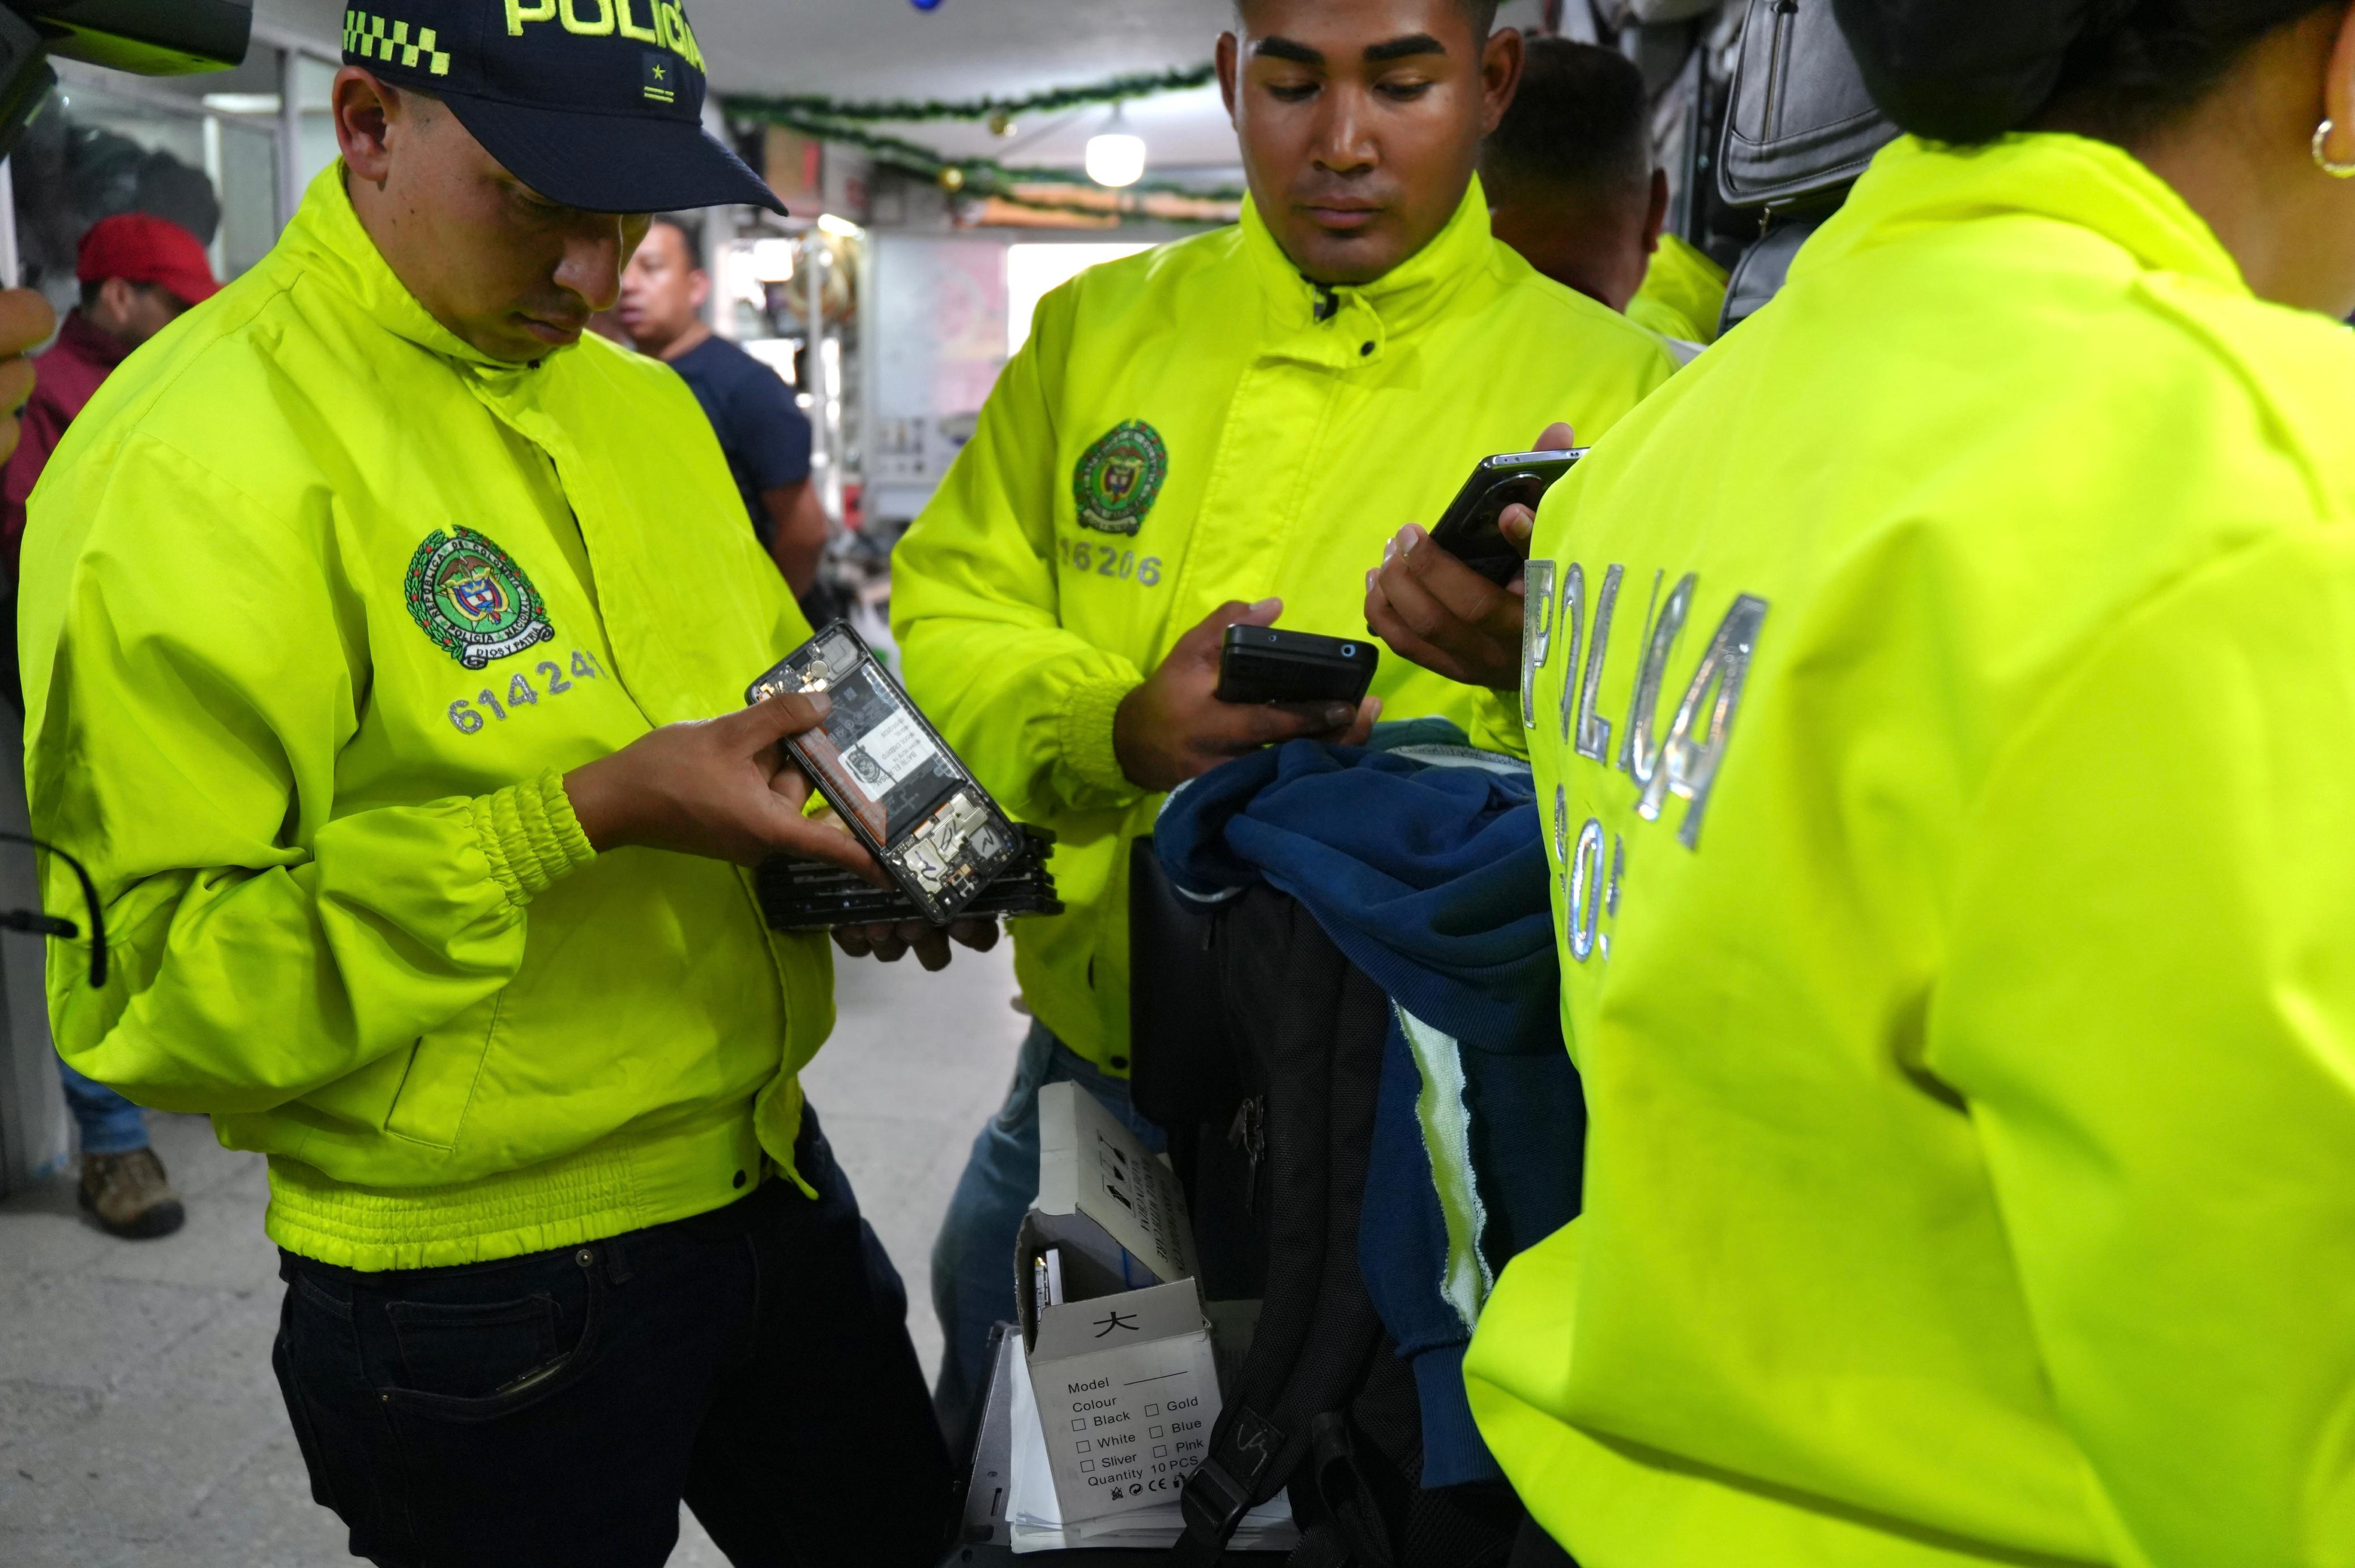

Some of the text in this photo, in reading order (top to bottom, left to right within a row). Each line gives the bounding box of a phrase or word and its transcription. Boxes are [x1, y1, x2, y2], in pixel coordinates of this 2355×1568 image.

[447, 597, 528, 642] POLICIA NACIONAL
[477, 647, 504, 657] DIOS
[512, 626, 540, 652] PATRIA
[1093, 1311, 1140, 1338] 大
[1068, 1377, 1110, 1394] Model
[1072, 1396, 1117, 1413] Colour
[1167, 1396, 1198, 1411] Gold
[1094, 1411, 1131, 1426] Black
[1172, 1420, 1202, 1434] Blue
[1097, 1433, 1136, 1449] White
[1176, 1438, 1204, 1453] Pink
[1102, 1453, 1137, 1468] Sliver
[1087, 1455, 1198, 1486] Quantity 10 PCS
